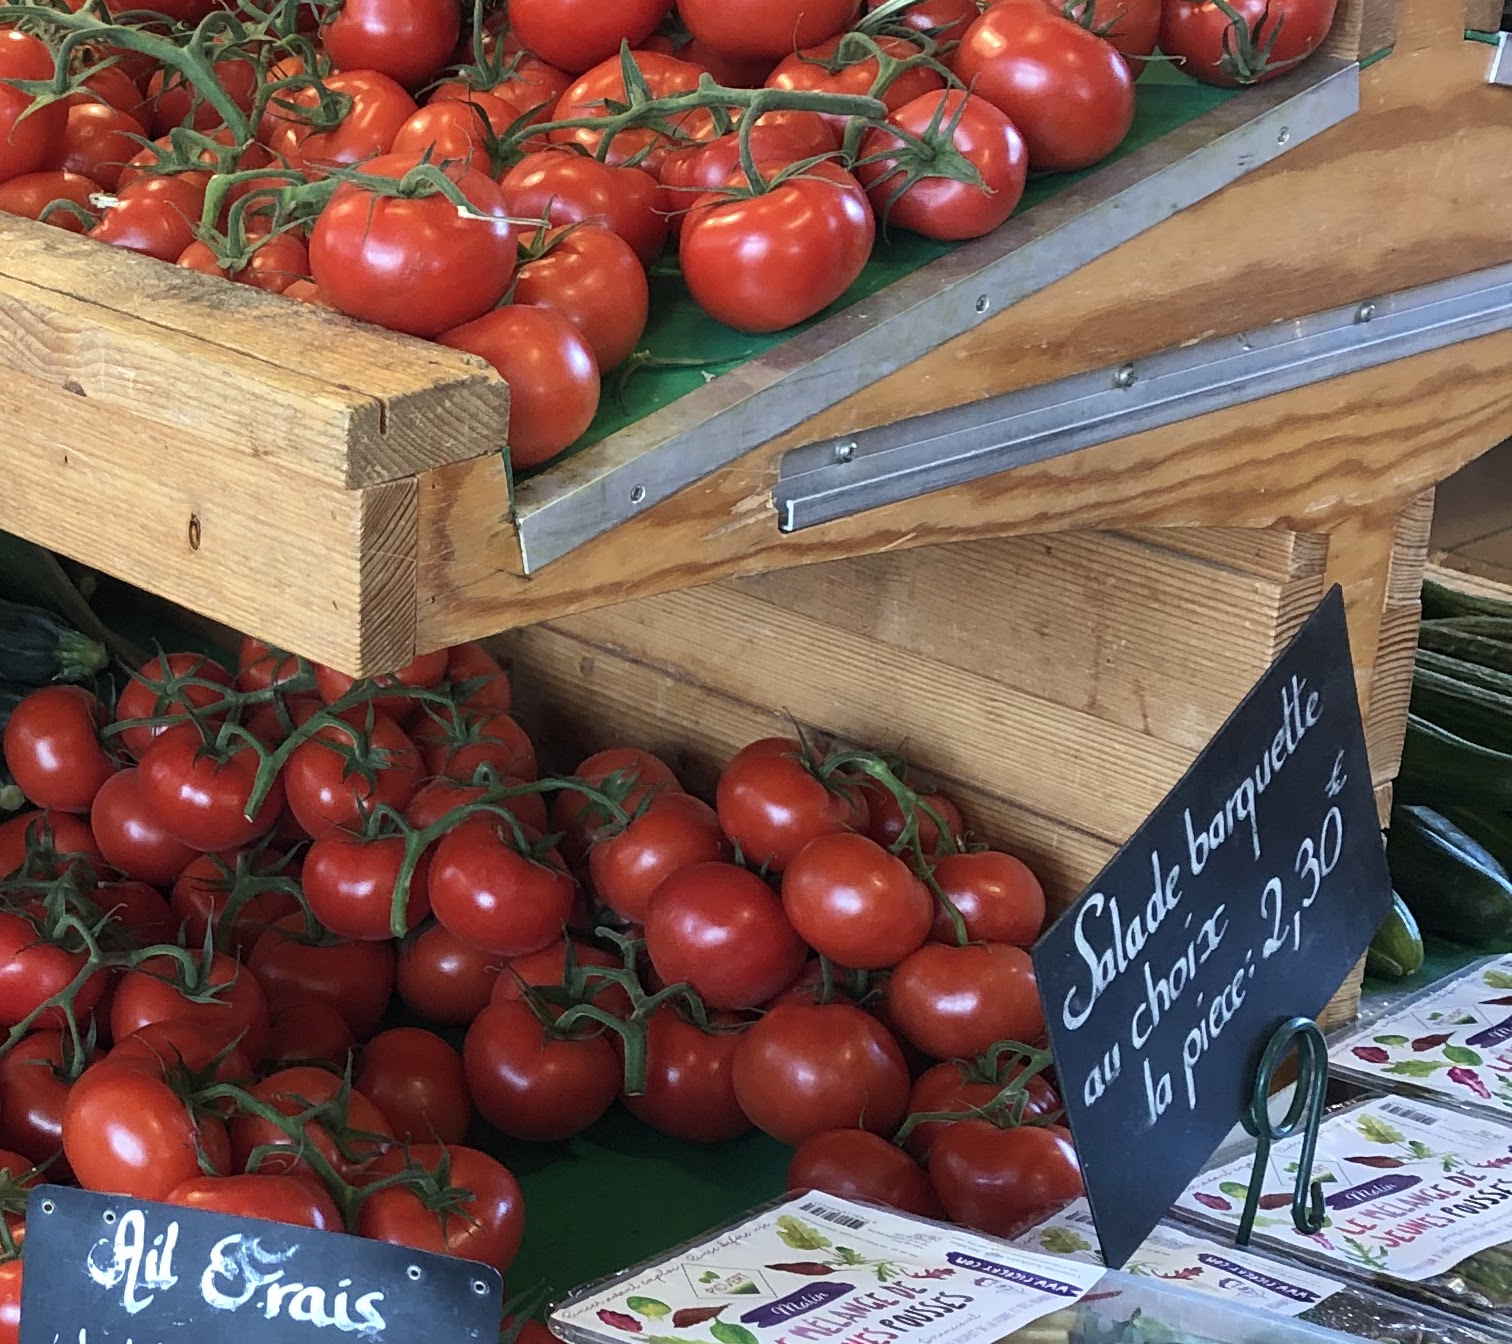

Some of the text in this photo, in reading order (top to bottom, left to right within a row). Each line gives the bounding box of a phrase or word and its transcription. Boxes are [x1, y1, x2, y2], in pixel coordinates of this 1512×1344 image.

[1062, 674, 1321, 1031] Salade barquette
[1084, 903, 1229, 1108] au choix
[1144, 1058, 1173, 1126] la
[1442, 1169, 1487, 1188] DE
[1369, 1213, 1456, 1248] JEUNES
[88, 1209, 388, 1334] Ail Frais
[878, 1280, 928, 1300] DE
[879, 1291, 974, 1332] POUSSES
